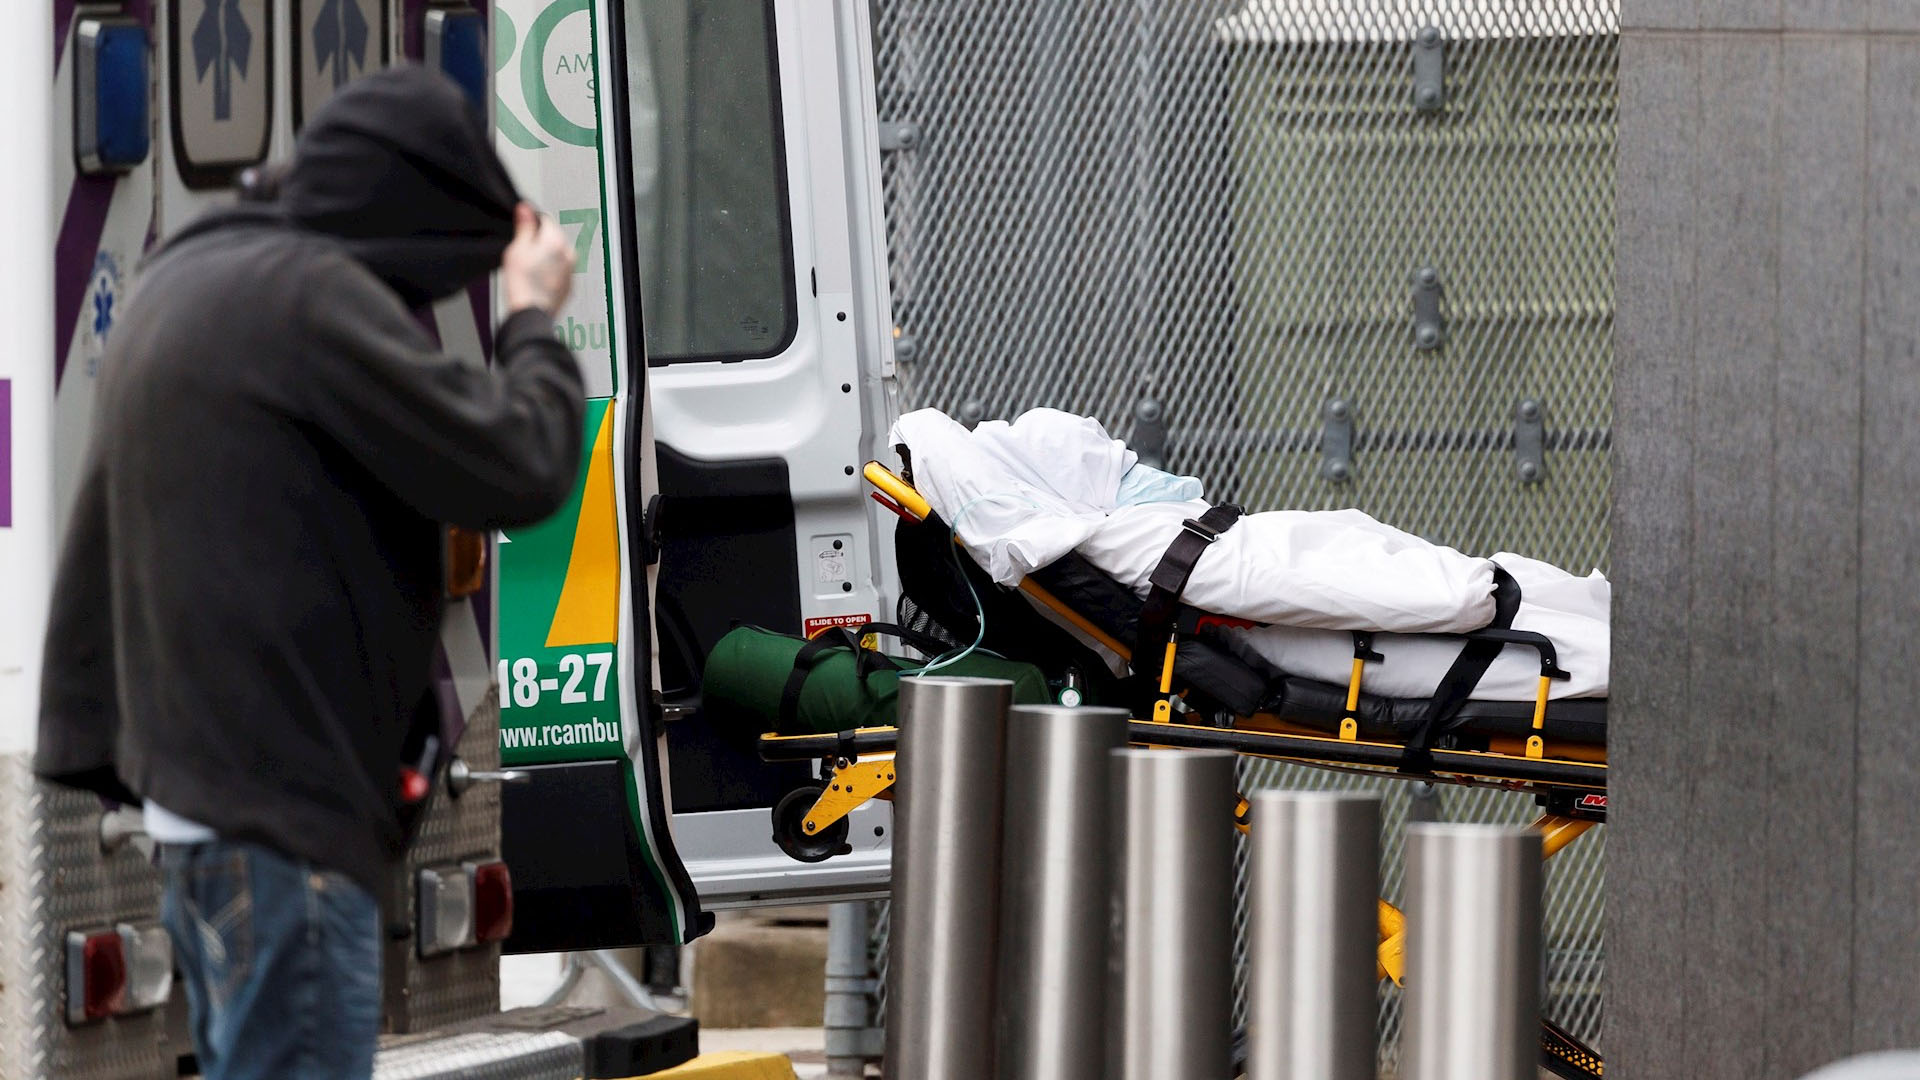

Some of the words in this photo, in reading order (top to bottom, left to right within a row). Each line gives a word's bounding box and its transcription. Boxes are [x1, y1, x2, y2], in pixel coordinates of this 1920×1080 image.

[559, 208, 600, 274] 7
[809, 618, 832, 626] SLIDE
[833, 617, 845, 625] TO
[499, 717, 619, 749] ww.rcambu
